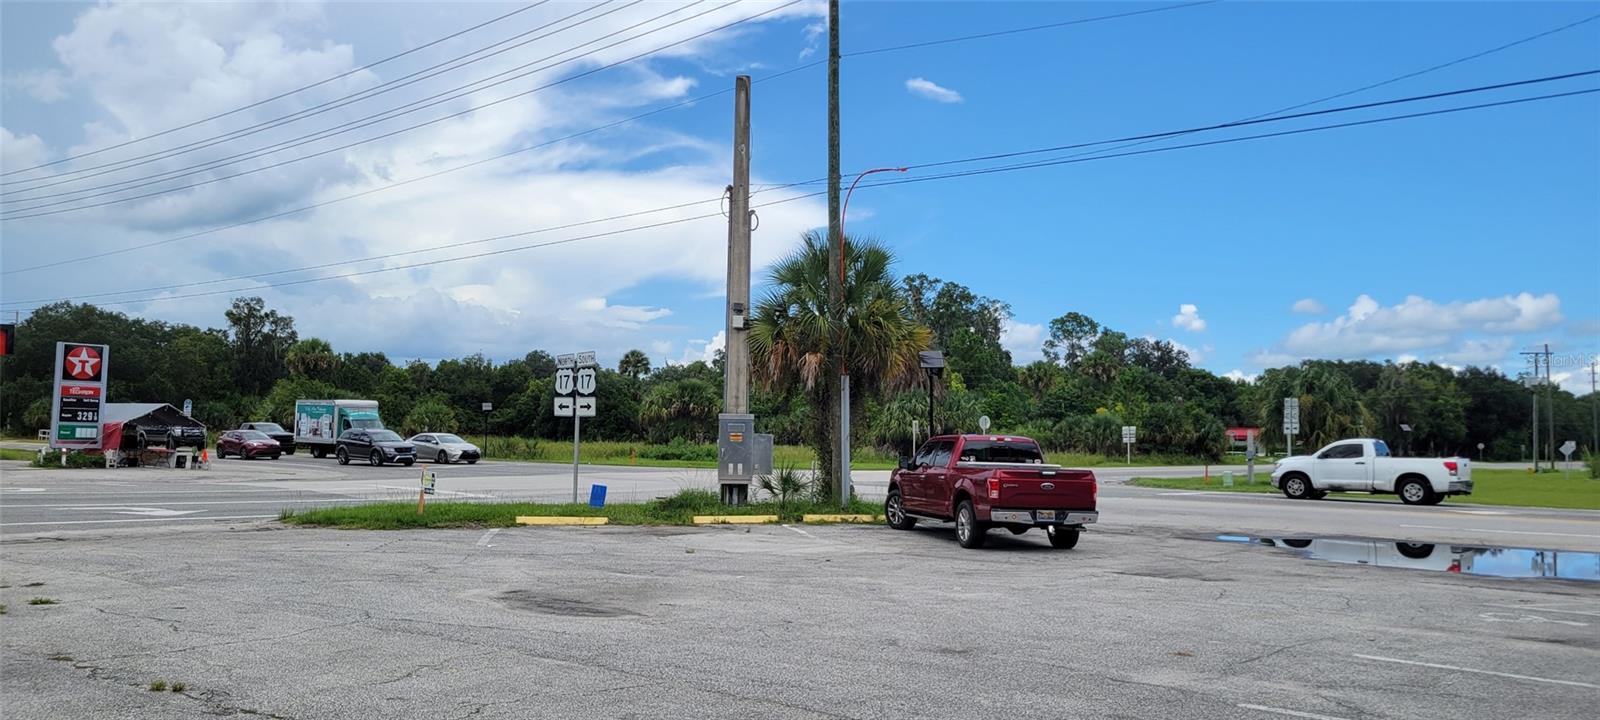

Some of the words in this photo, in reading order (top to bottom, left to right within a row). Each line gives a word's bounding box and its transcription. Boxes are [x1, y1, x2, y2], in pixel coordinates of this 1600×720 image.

[578, 354, 595, 364] SOUTH
[559, 374, 570, 389] 17
[581, 374, 592, 389] 17
[77, 411, 93, 421] 329
